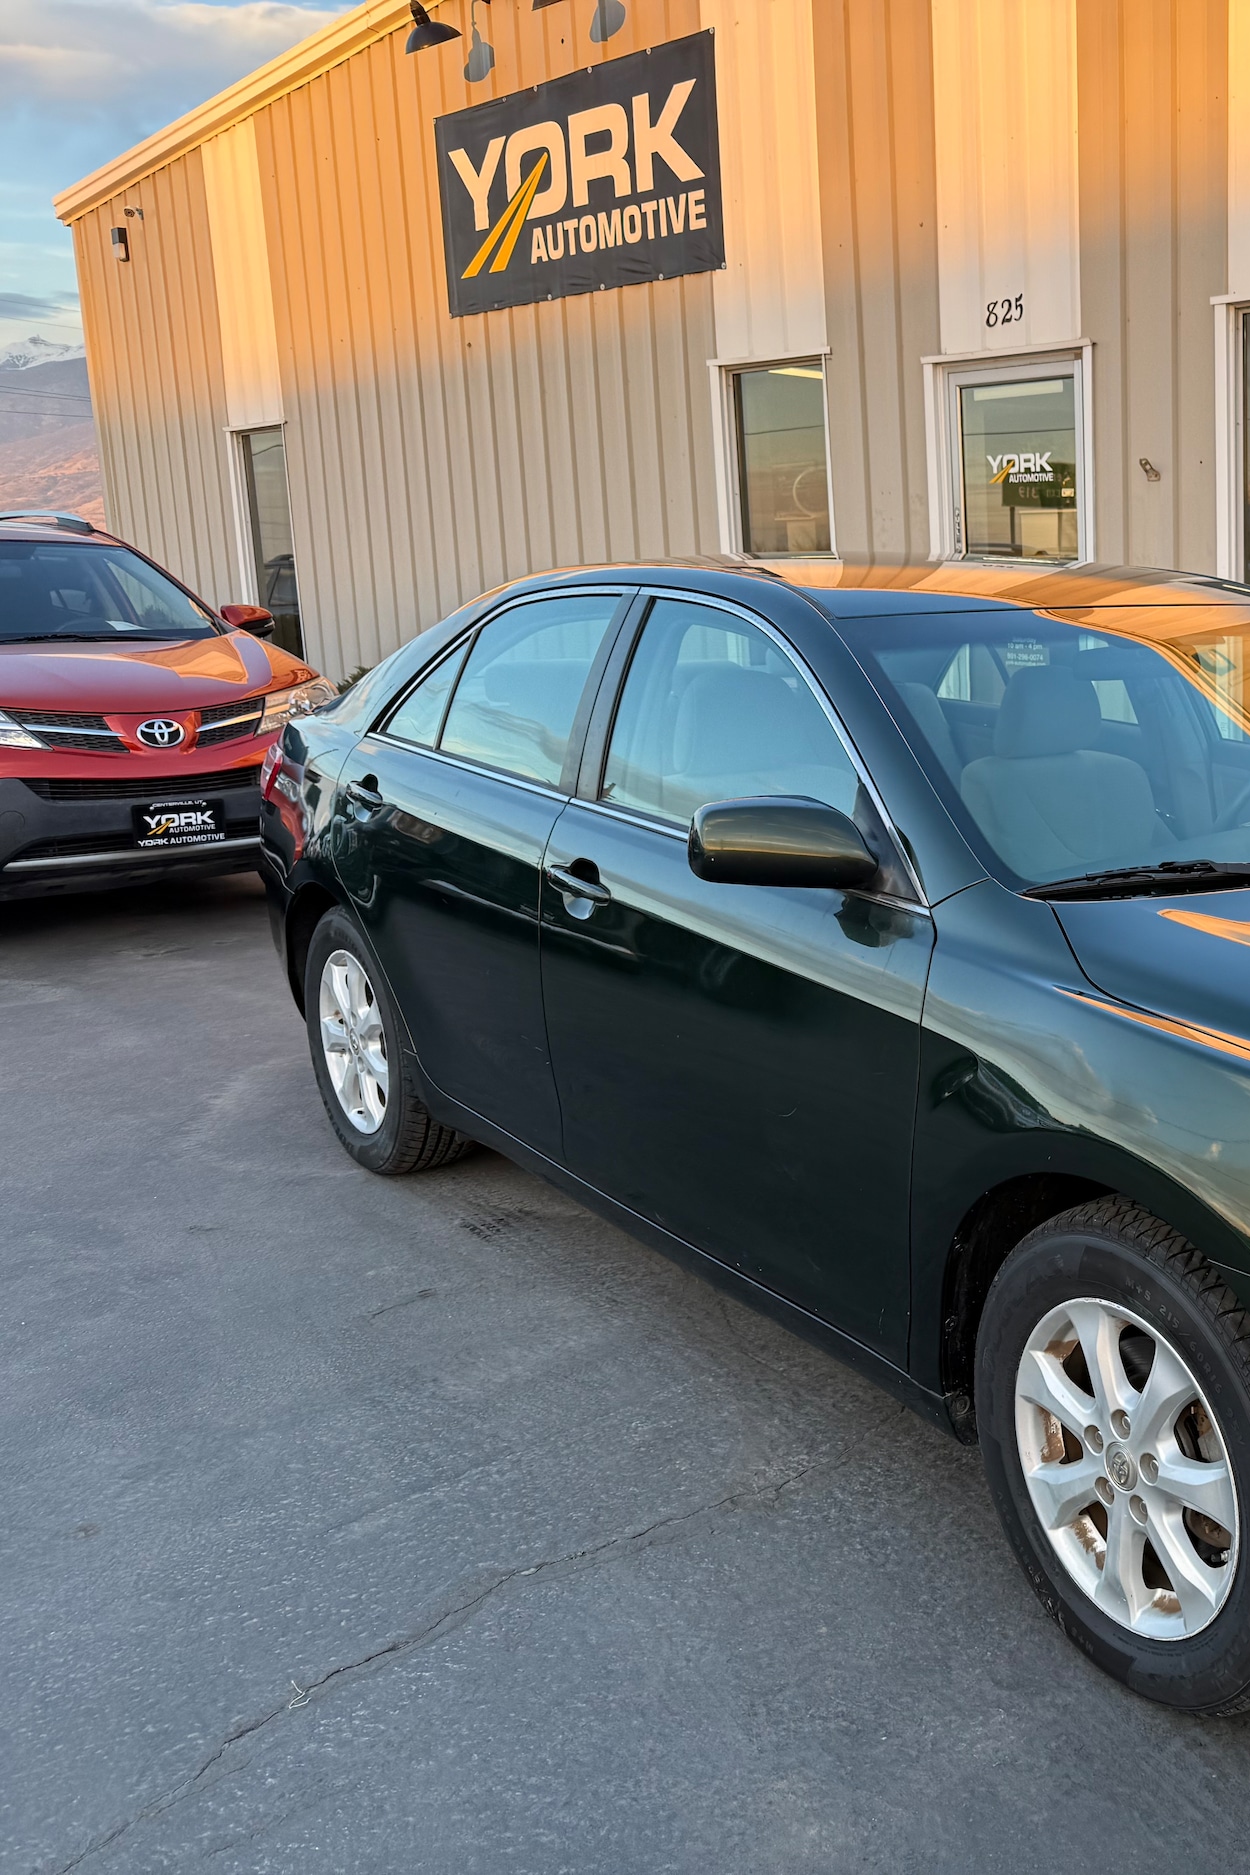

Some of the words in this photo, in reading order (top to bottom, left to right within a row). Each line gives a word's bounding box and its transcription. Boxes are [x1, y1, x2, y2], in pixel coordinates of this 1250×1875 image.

[448, 78, 705, 231] YORK
[531, 189, 707, 264] AUTOMOTIVE
[985, 294, 1024, 328] 825
[986, 452, 1053, 474] YORK
[1009, 472, 1054, 483] AUTOMOTIVE
[143, 810, 215, 829] YORK
[169, 824, 216, 834] AUTOMOTIVE
[138, 838, 169, 847] YORK
[170, 833, 225, 844] AUTOMOTIVE
